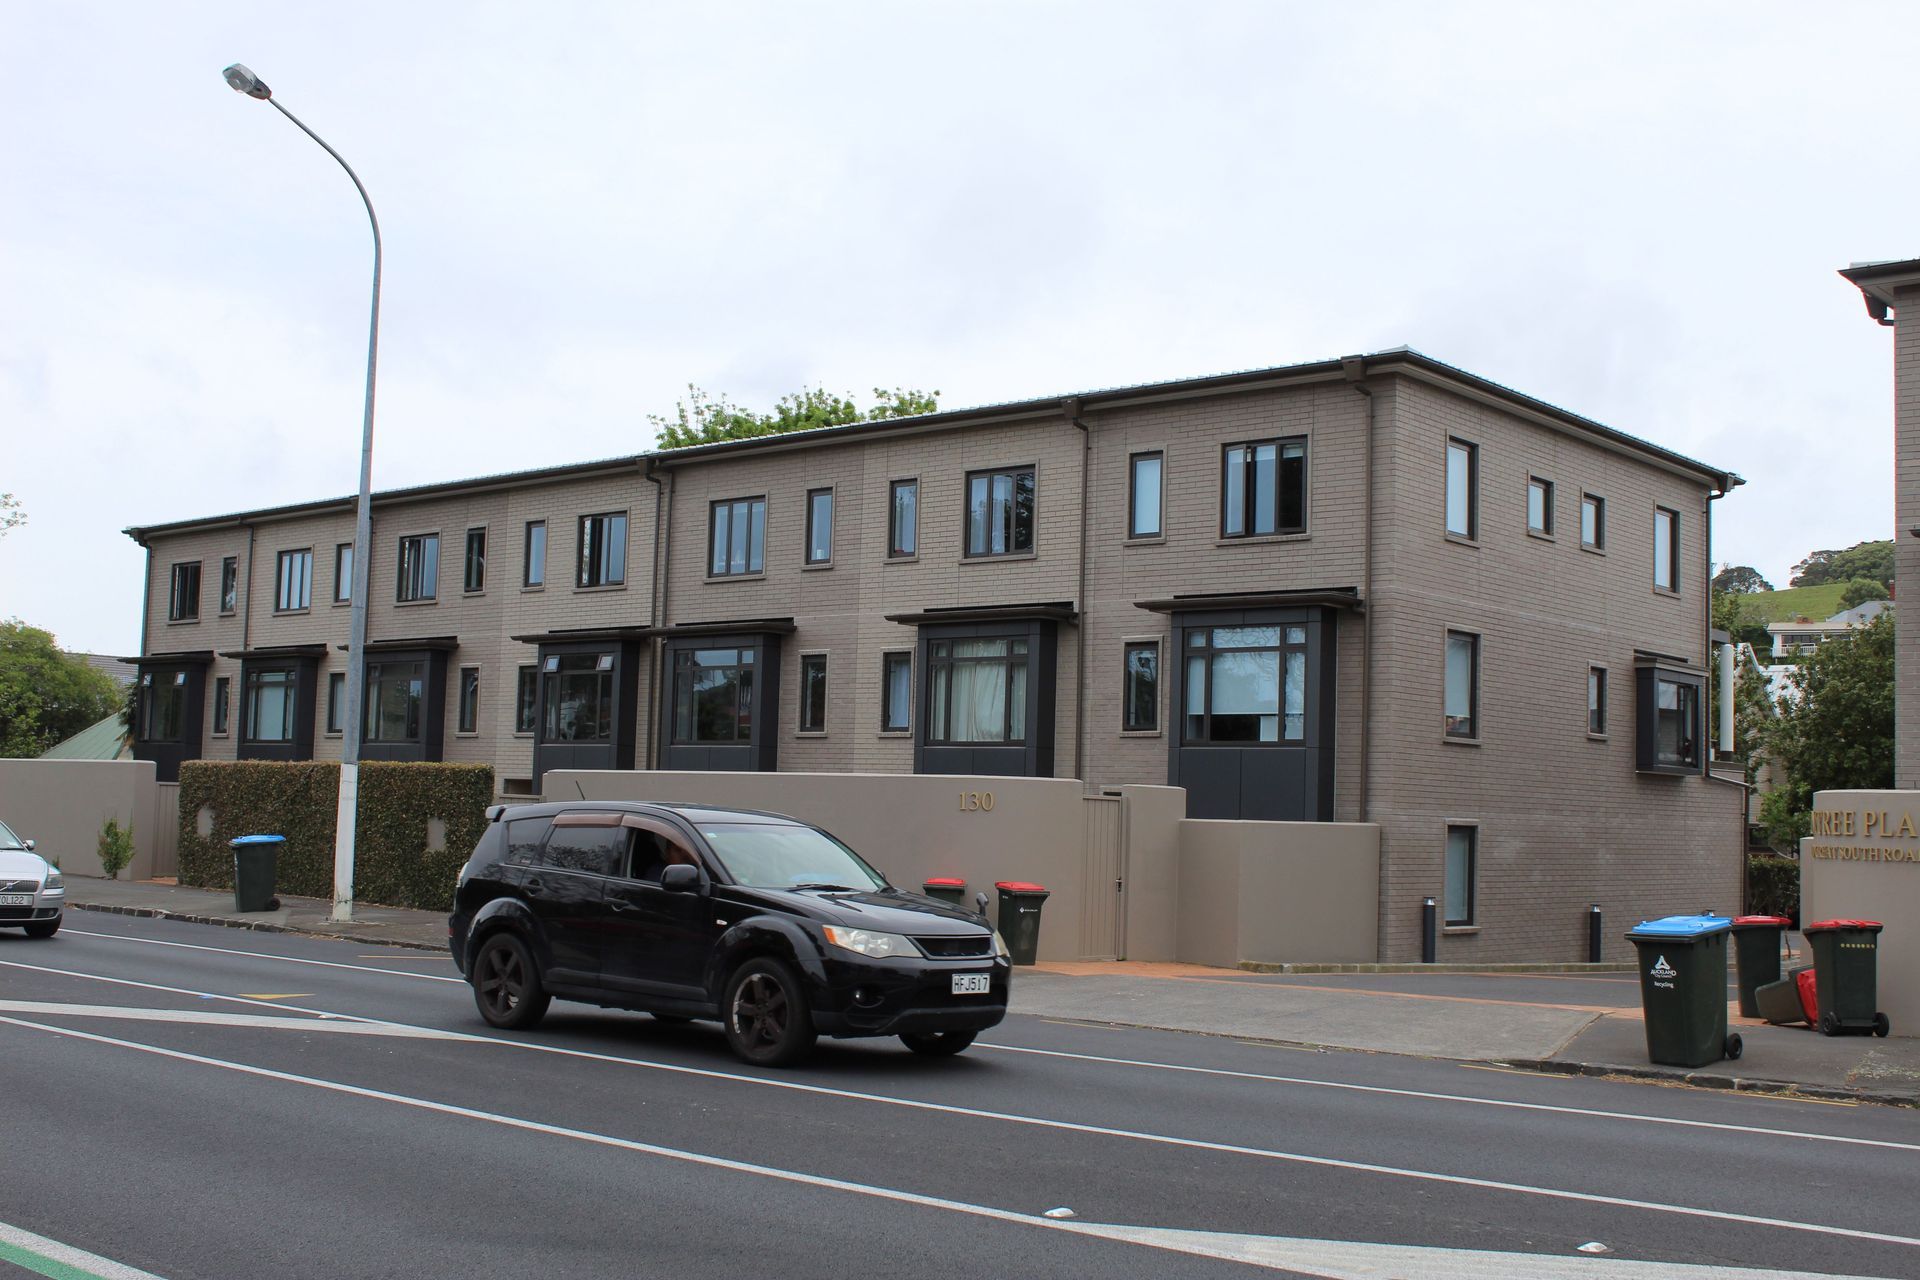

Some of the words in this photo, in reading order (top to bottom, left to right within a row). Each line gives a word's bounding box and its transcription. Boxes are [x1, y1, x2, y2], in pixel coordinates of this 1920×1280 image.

[959, 791, 994, 811] 130
[1839, 846, 1880, 861] SOUTH
[1883, 847, 1920, 863] ROA
[0, 895, 24, 905] OL122
[953, 976, 988, 991] HFJ517
